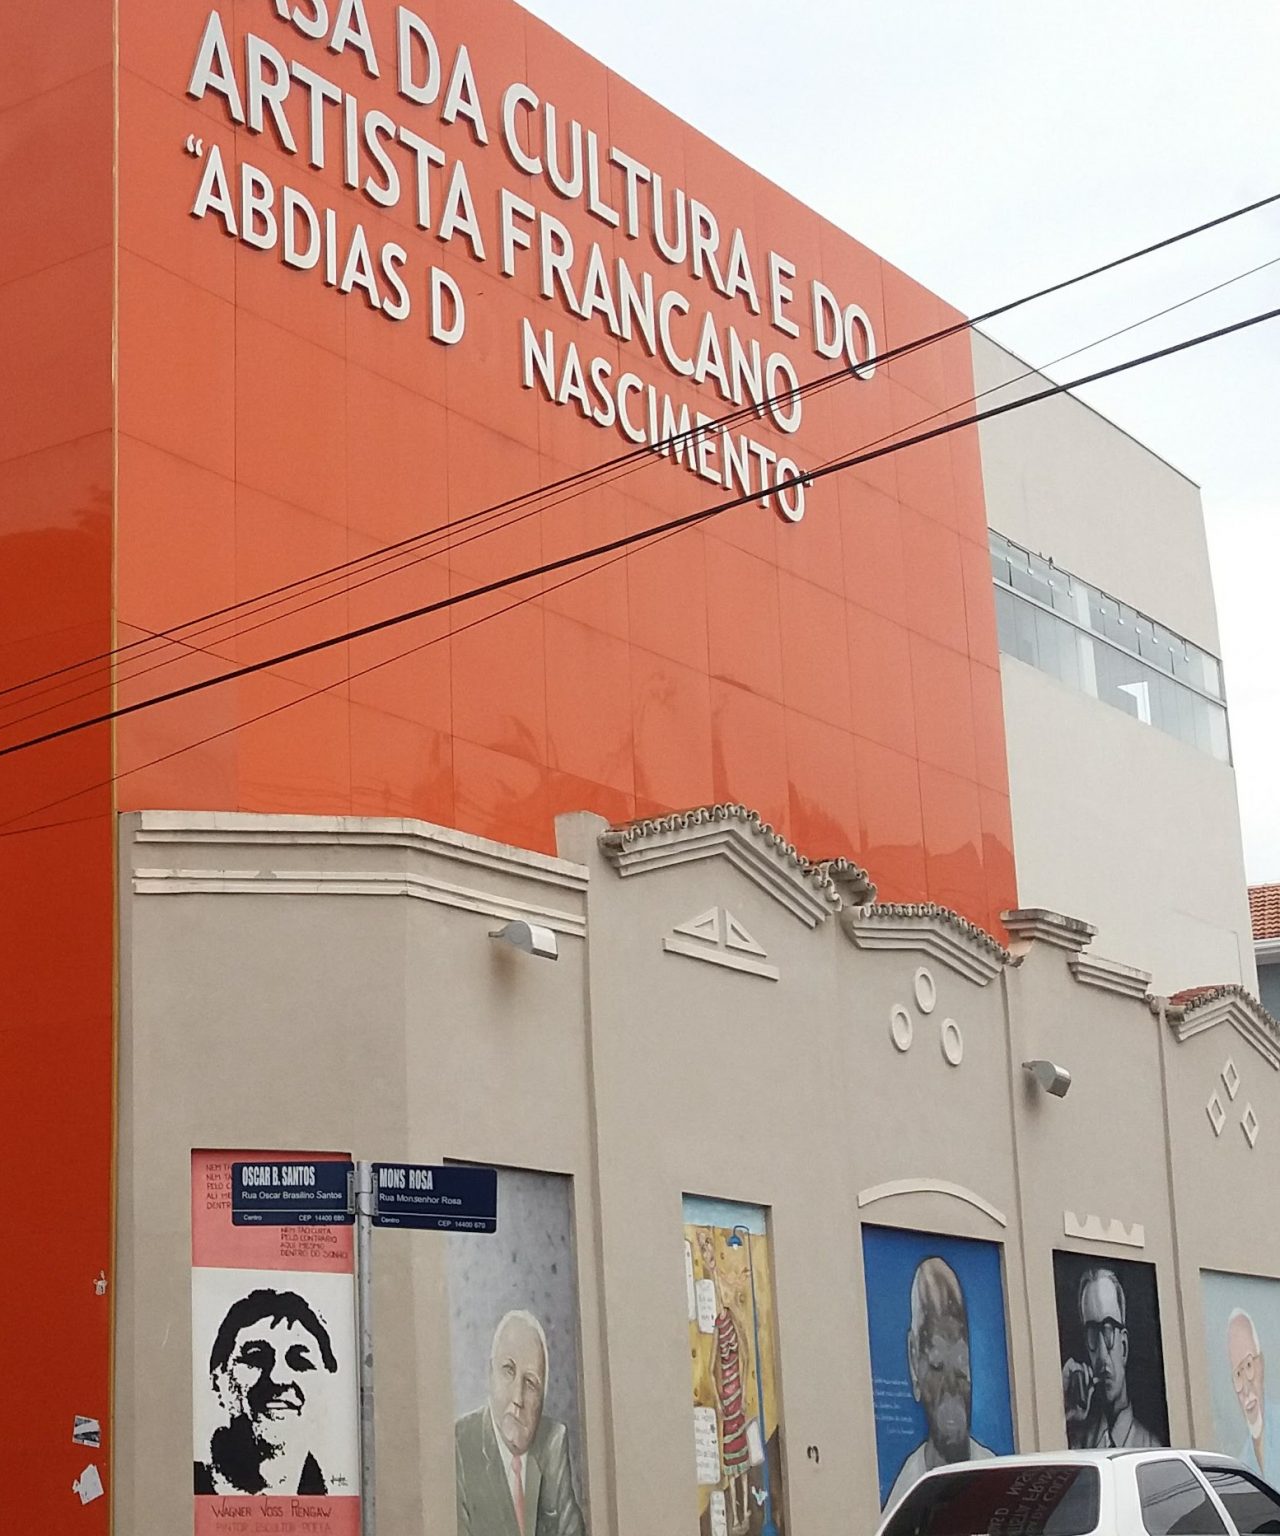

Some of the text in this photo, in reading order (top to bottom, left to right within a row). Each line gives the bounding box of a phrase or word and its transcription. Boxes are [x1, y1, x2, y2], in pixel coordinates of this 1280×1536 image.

[397, 5, 489, 146] DA
[502, 82, 761, 315] CULTURA
[768, 250, 800, 338] E
[813, 279, 877, 380] DO
[186, 10, 803, 434] ARTISTA FRANCANO
[429, 265, 466, 345] D
[242, 1166, 315, 1186] OSCAR B. SANTOS
[379, 1168, 433, 1190] MONS ROSA
[242, 1190, 342, 1199] Rua Oscar Brasilino Santos
[397, 1195, 440, 1204] Monsenhor
[441, 1197, 462, 1205] Rosa
[211, 1498, 252, 1517] WAGNER
[261, 1497, 284, 1517] VOSS
